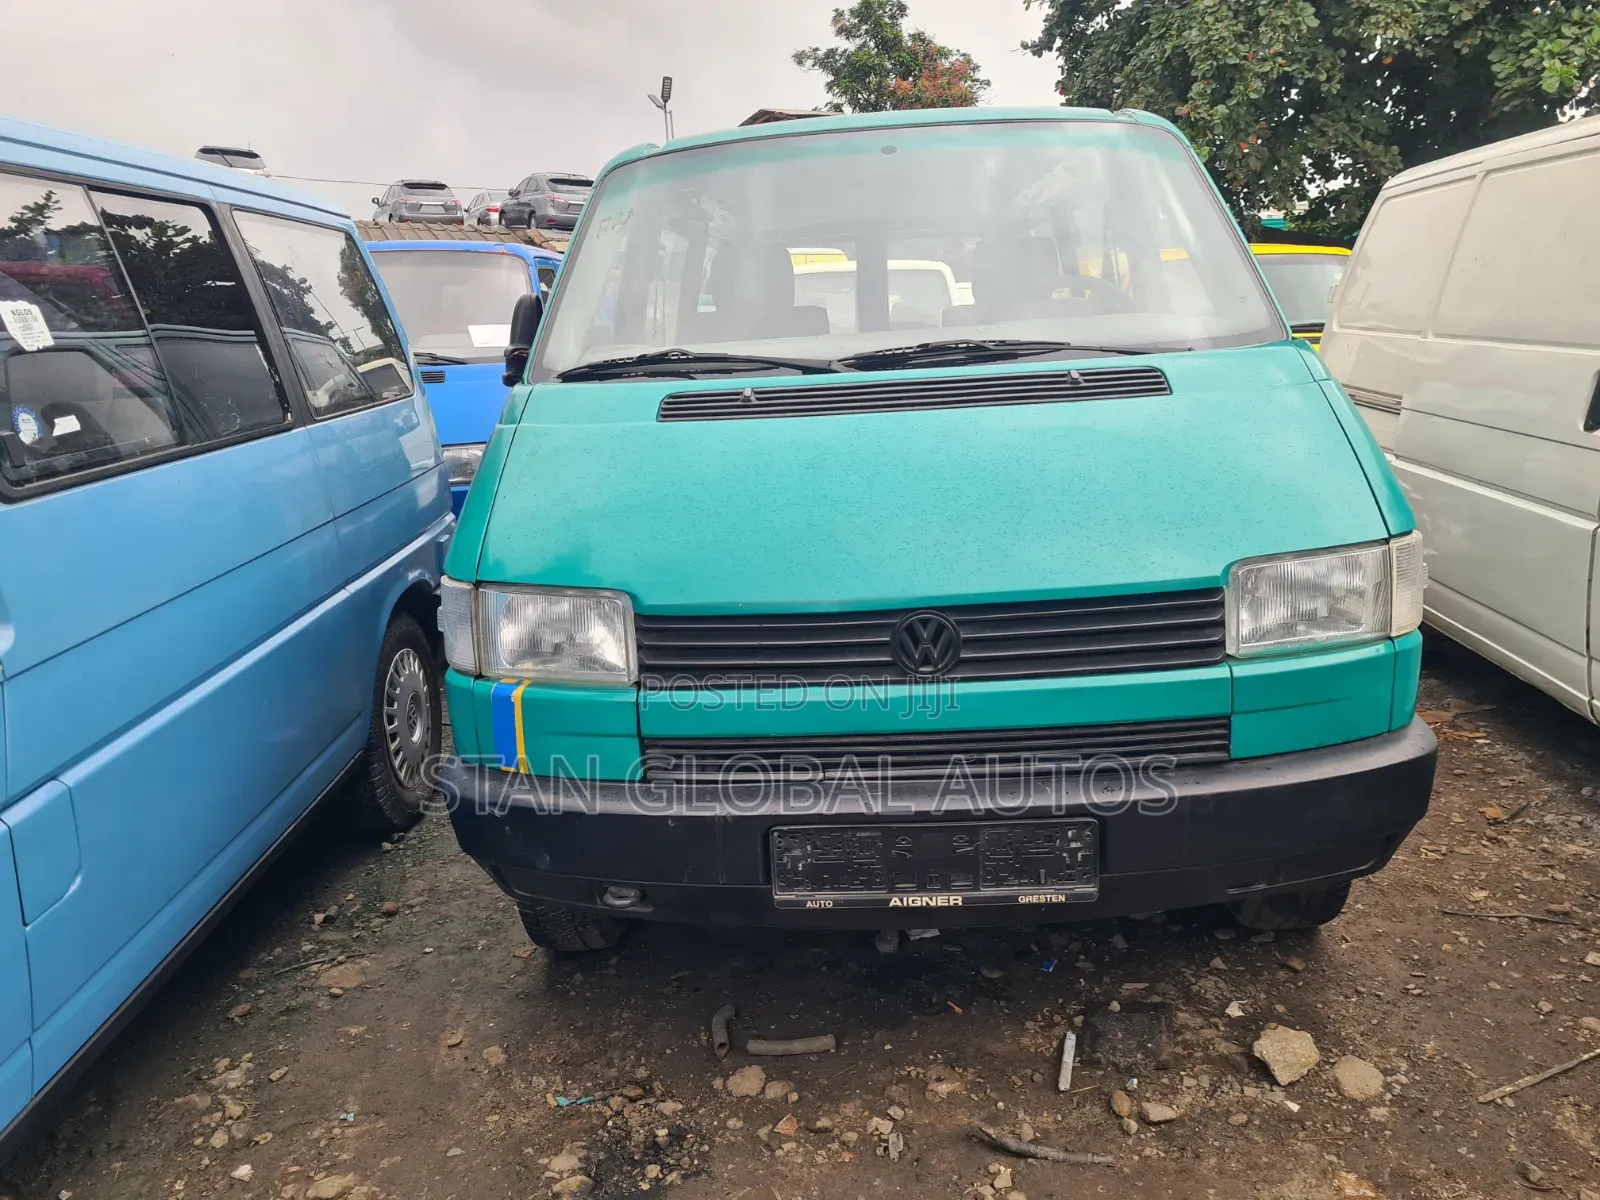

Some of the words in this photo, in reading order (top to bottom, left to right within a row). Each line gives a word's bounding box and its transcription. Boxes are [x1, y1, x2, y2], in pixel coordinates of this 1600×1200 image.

[806, 900, 833, 908] AUTO
[889, 895, 963, 908] AIGNER
[1018, 894, 1066, 904] GRESTEN
